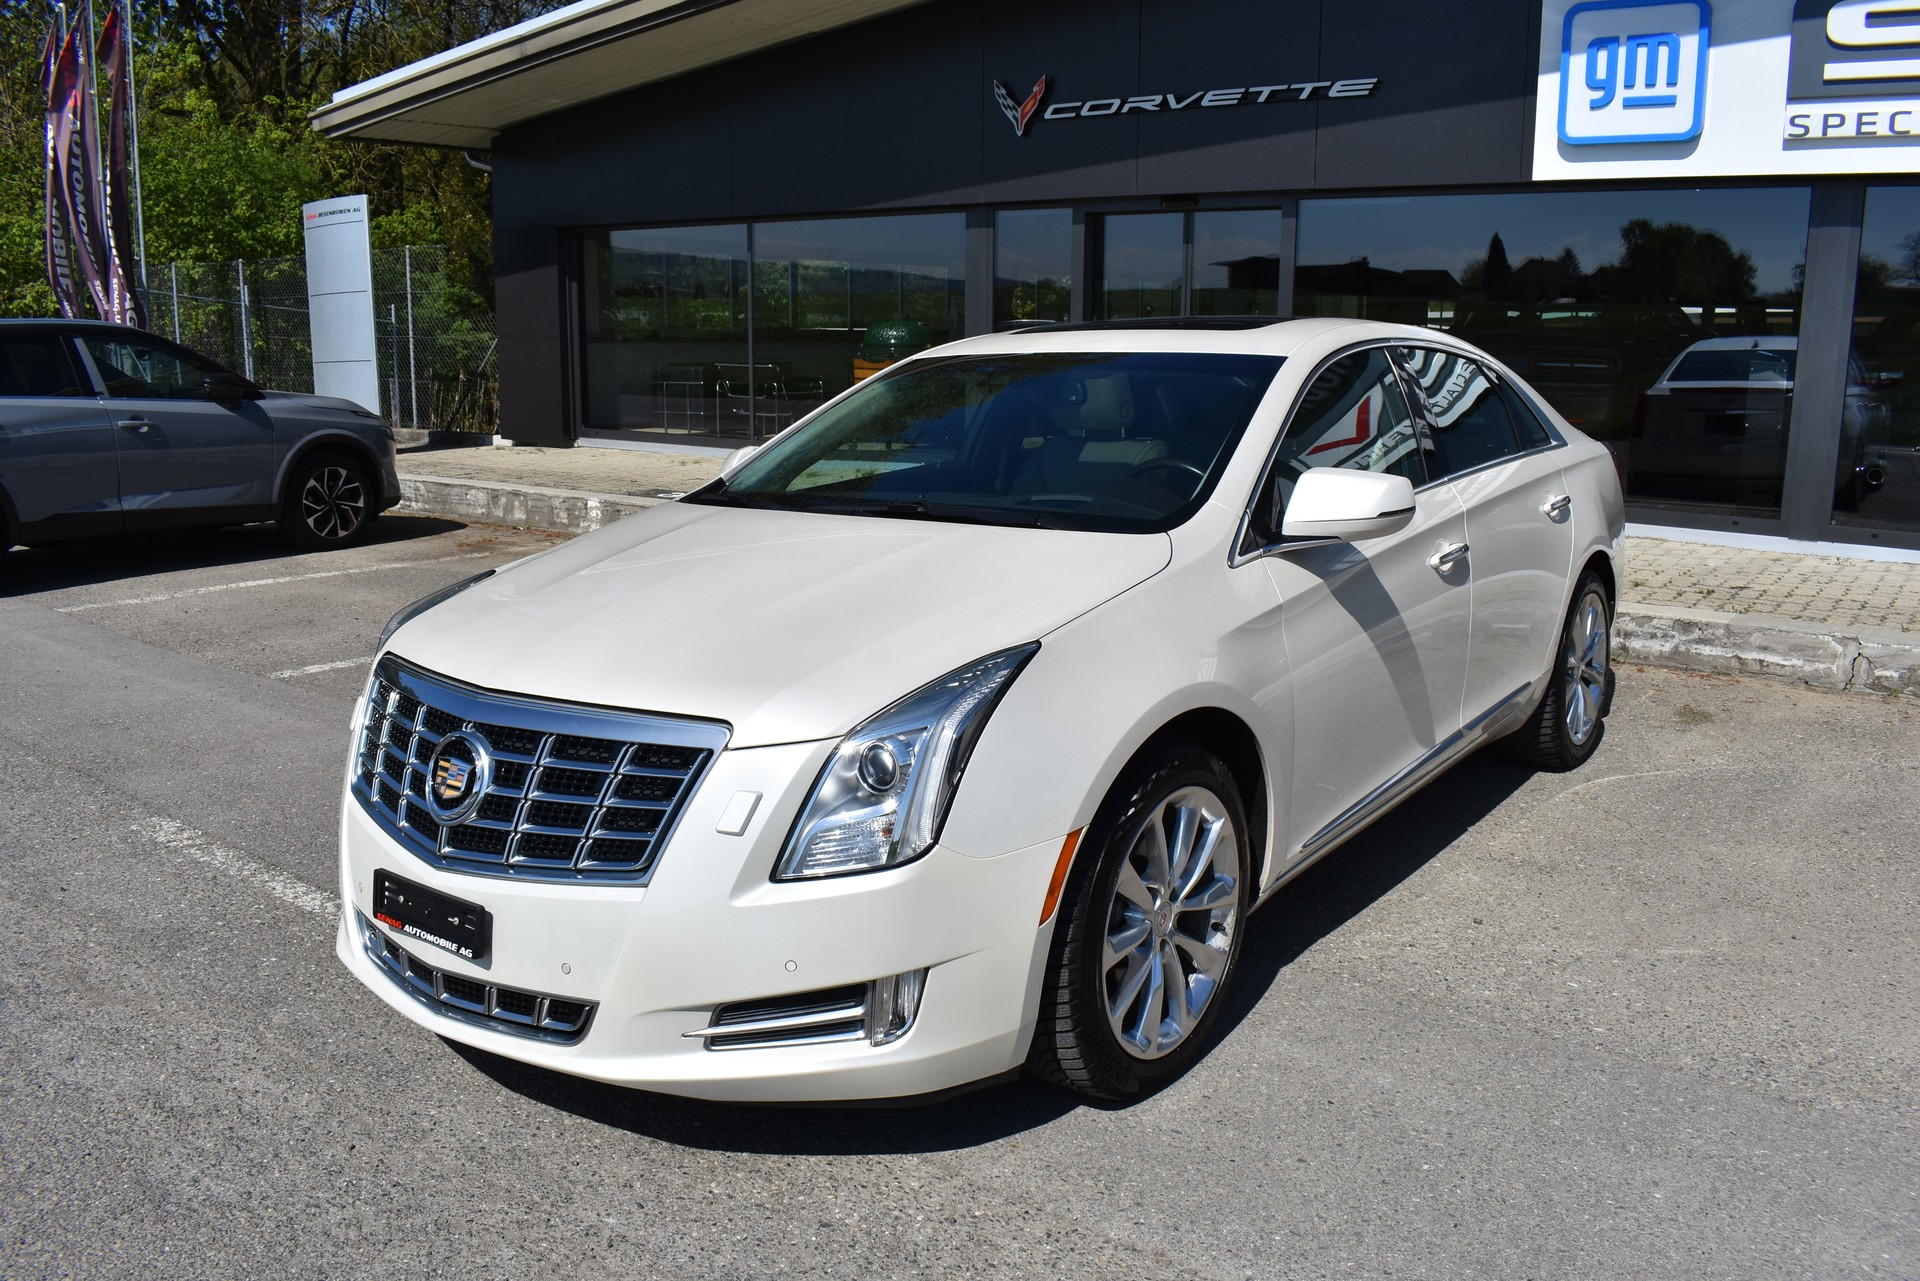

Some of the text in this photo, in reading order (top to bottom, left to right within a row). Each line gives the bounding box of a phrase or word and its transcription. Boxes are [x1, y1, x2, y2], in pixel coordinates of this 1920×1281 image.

[1585, 32, 1681, 111] gm
[1043, 77, 1378, 120] CORVETTE
[377, 912, 473, 958] SENAG AUTOMOBILE AG
